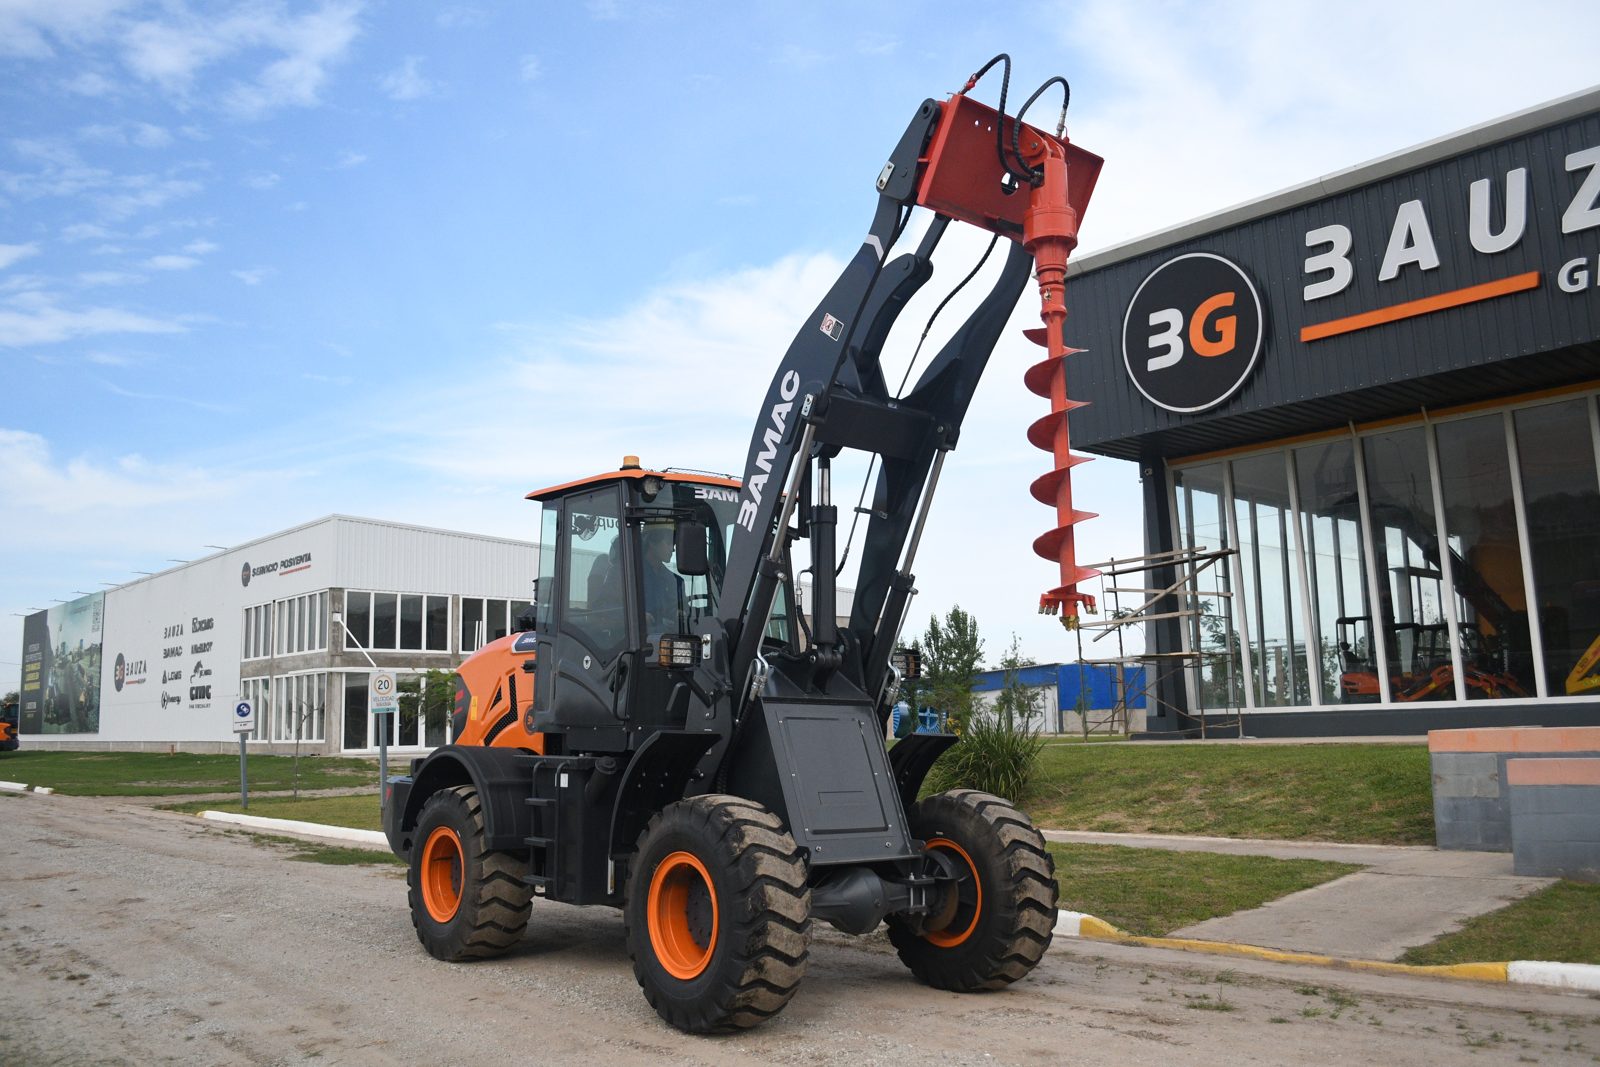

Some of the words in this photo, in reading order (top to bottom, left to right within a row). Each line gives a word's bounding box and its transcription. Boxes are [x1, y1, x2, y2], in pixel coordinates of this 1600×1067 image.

[252, 562, 278, 577] SERVICIO
[280, 552, 312, 569] POSVENTA
[378, 680, 389, 689] 20
